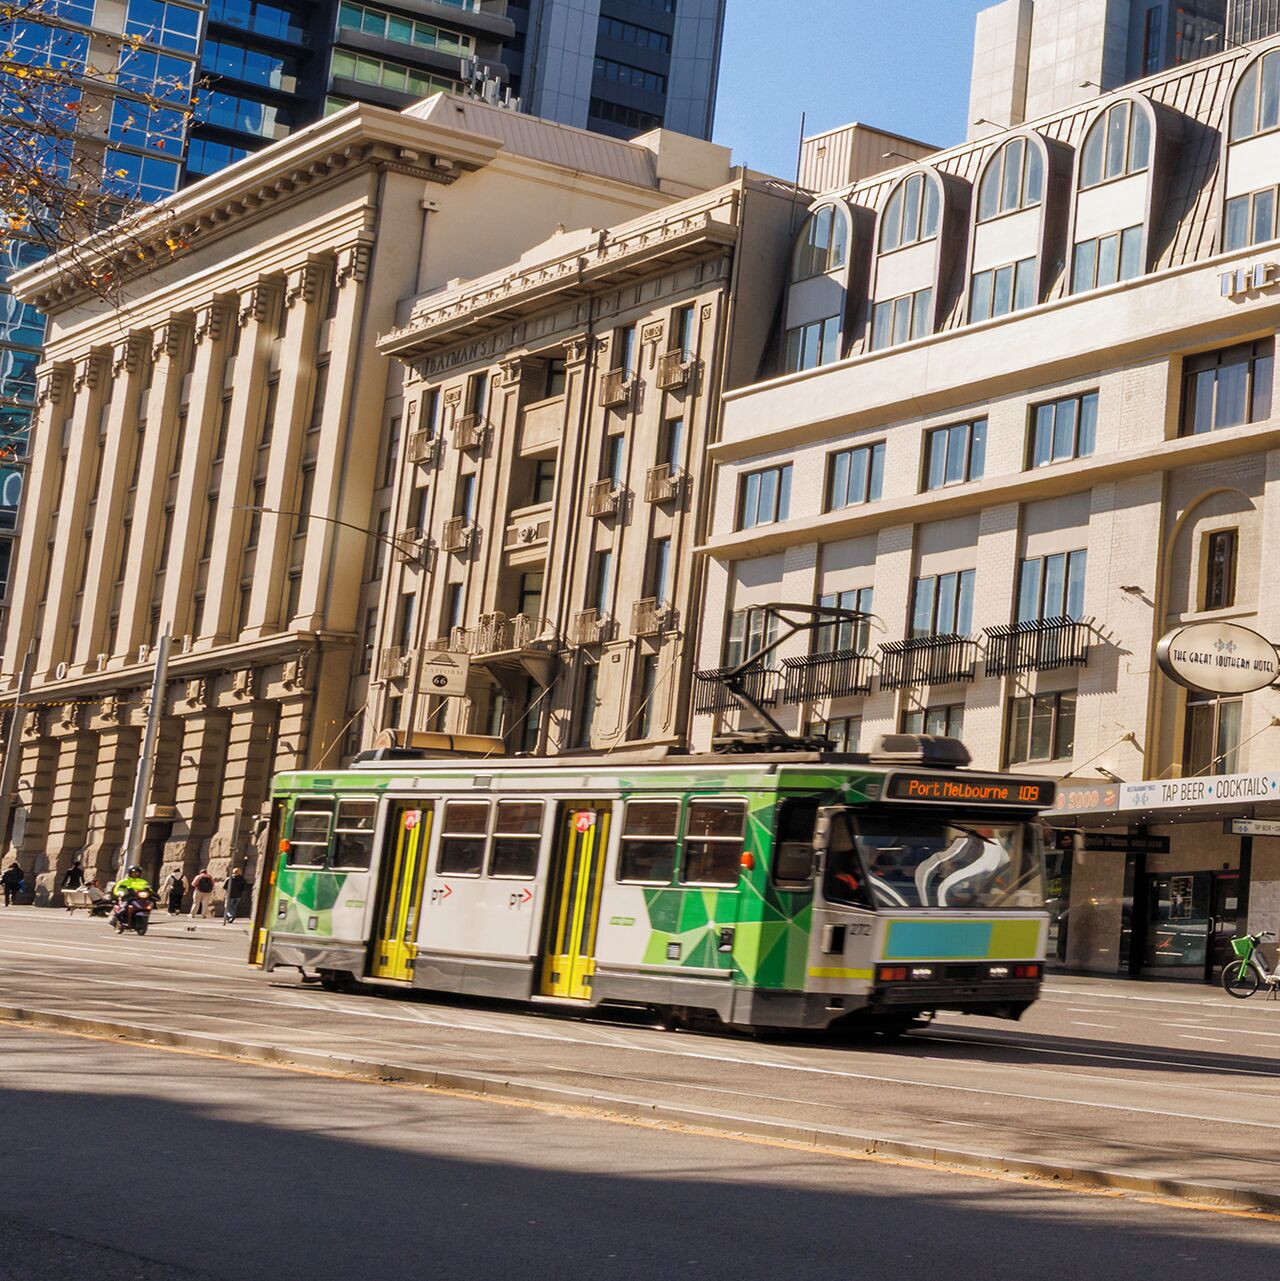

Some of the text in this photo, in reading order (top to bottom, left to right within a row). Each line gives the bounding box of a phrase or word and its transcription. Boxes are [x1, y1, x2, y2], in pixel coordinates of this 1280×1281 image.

[1217, 260, 1275, 297] THE
[1173, 649, 1275, 673] THE GREAT SOUTHERN HOTEL
[434, 676, 446, 685] 66
[908, 780, 1040, 801] Port Melbourne 109
[1161, 784, 1178, 802] TAP
[1180, 782, 1205, 801] BEER
[1215, 778, 1269, 799] COCKTAILS
[849, 923, 872, 936] 272
